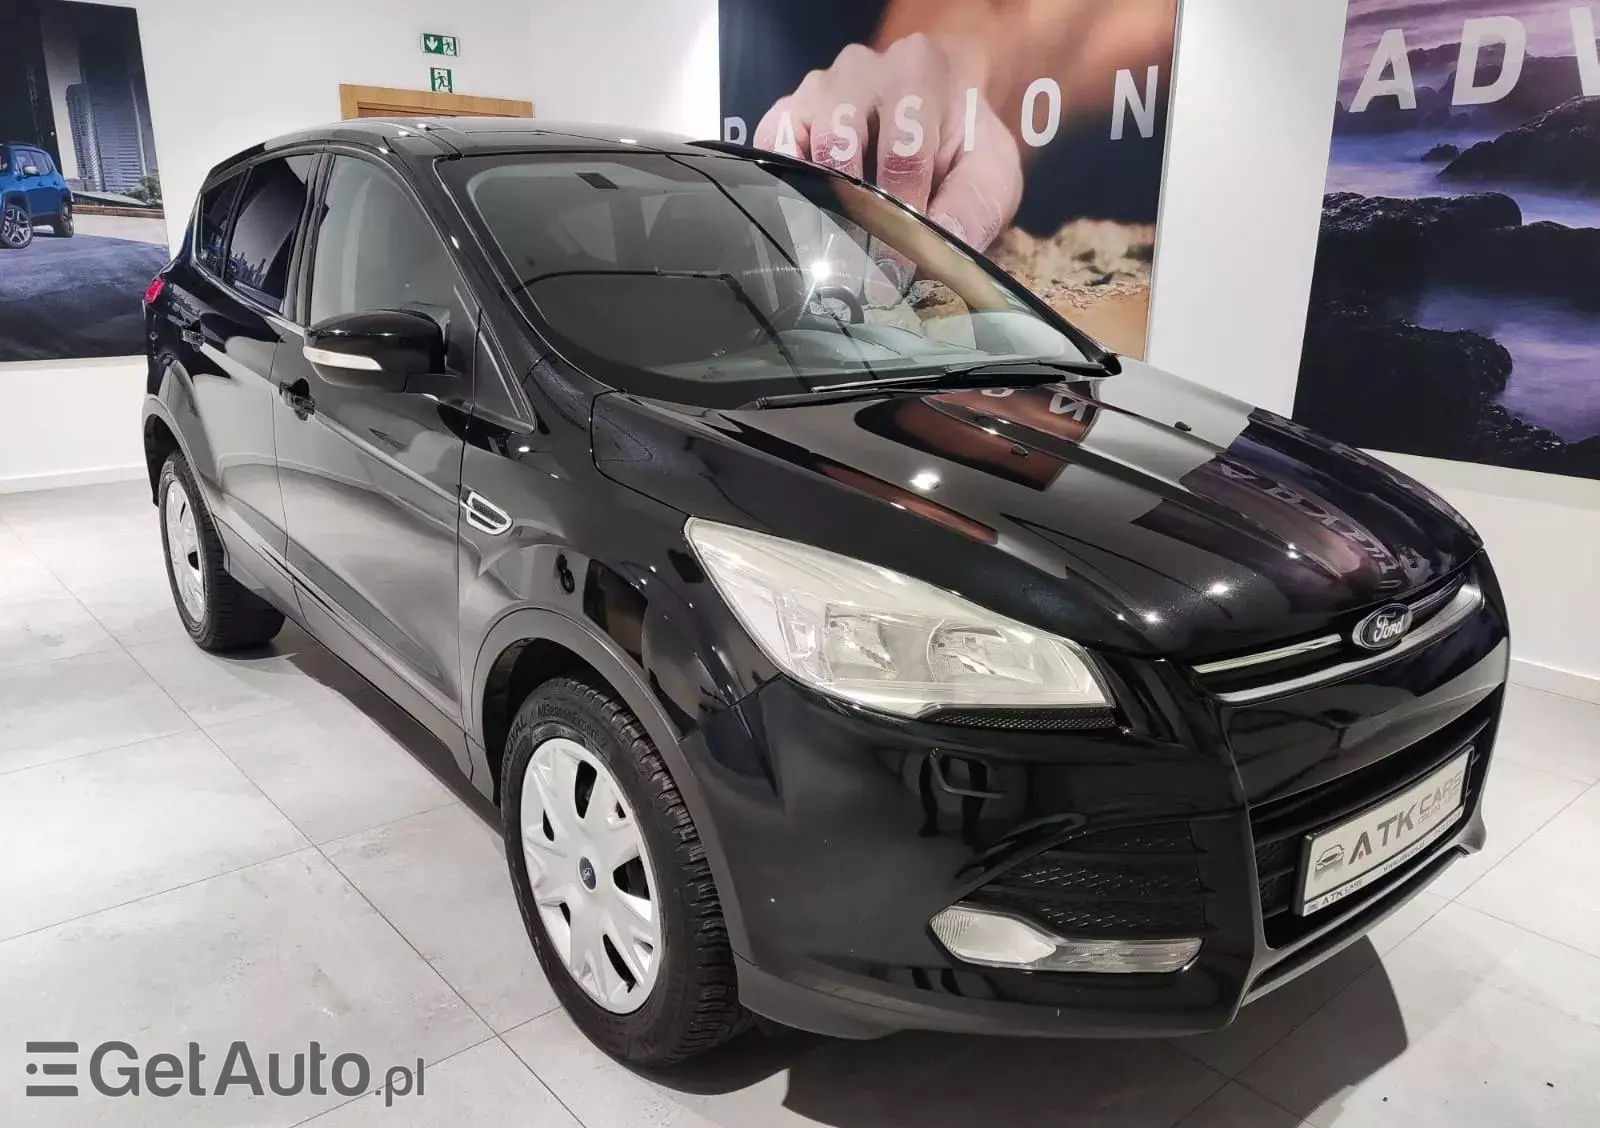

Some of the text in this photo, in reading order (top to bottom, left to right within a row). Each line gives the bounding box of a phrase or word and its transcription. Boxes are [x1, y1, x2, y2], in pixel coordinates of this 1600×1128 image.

[723, 65, 1159, 162] PASSION
[1373, 611, 1405, 643] Ford
[1348, 800, 1419, 865] ATK
[1419, 769, 1463, 815] CARS
